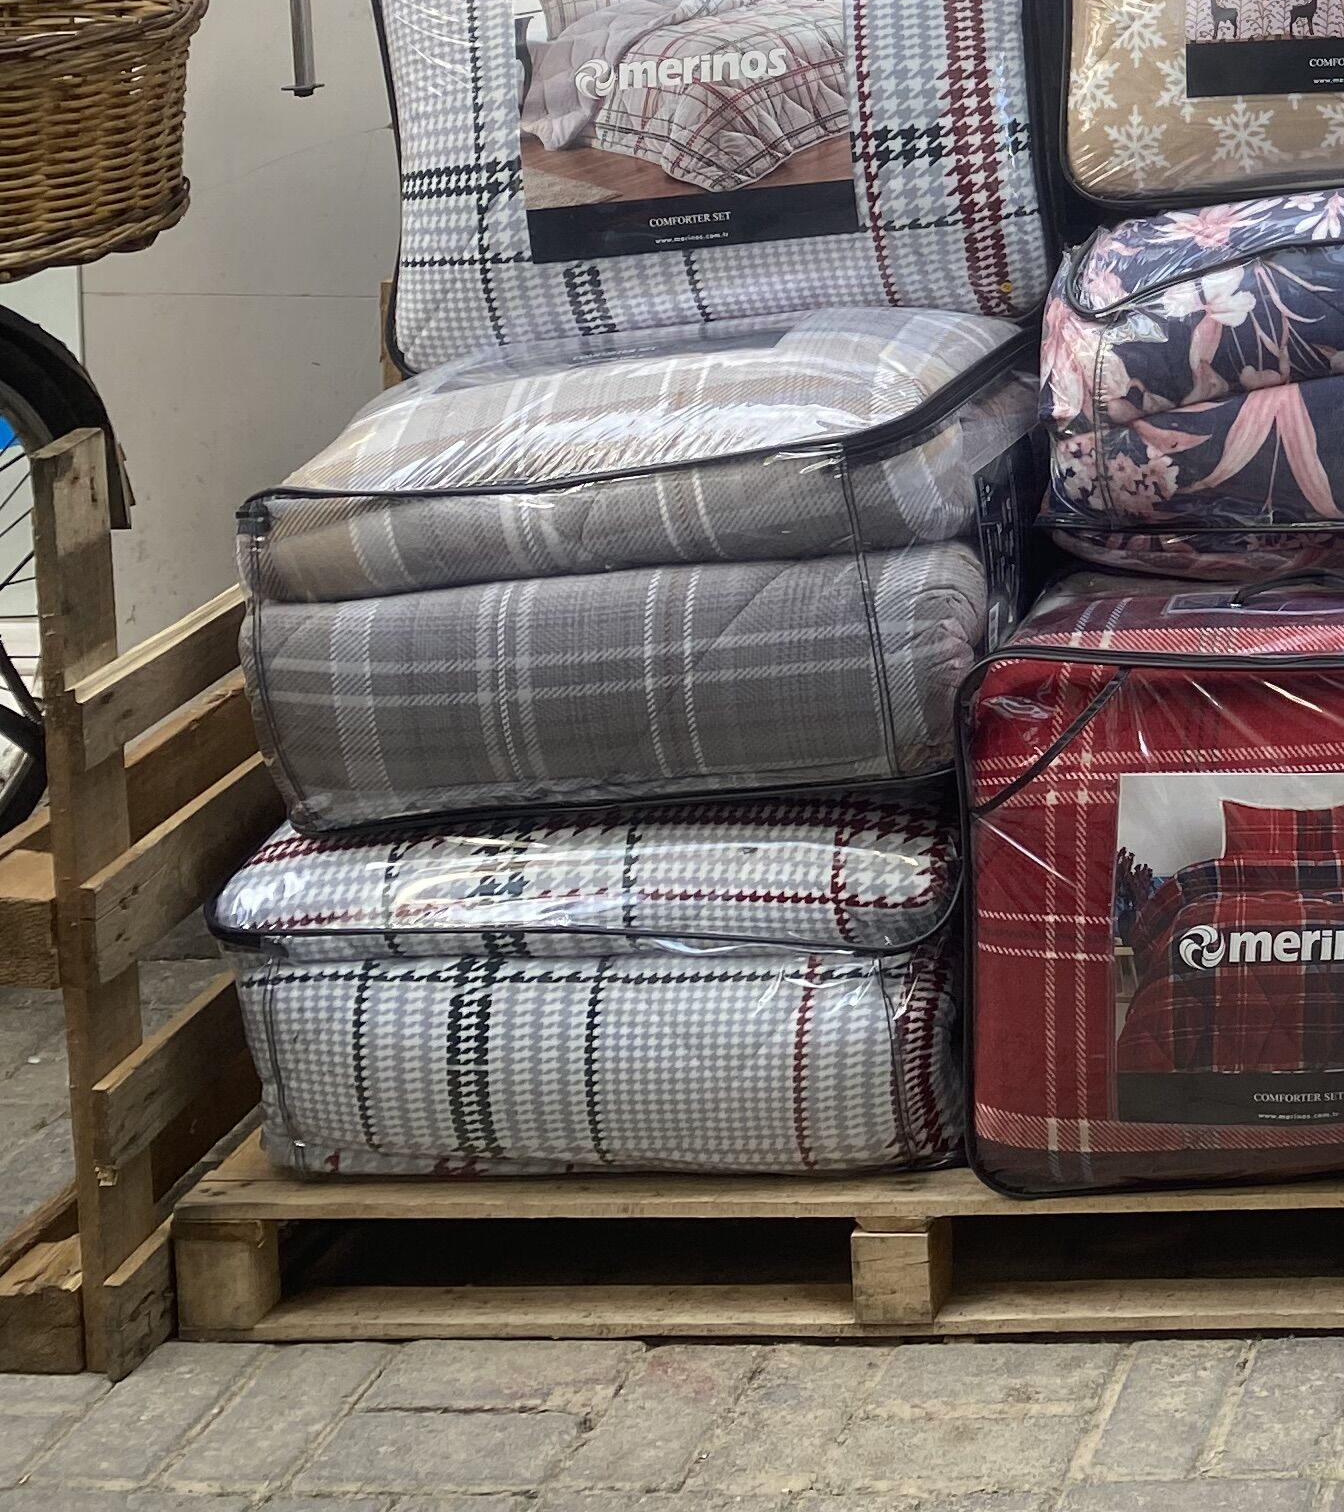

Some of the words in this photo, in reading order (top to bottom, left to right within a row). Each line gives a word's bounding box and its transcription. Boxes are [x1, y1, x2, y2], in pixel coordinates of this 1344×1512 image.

[618, 47, 787, 89] merinos
[649, 213, 711, 228] COMFORTER
[712, 210, 732, 223] SET
[1253, 1091, 1322, 1103] COMFORTER
[1323, 1090, 1344, 1102] SET
